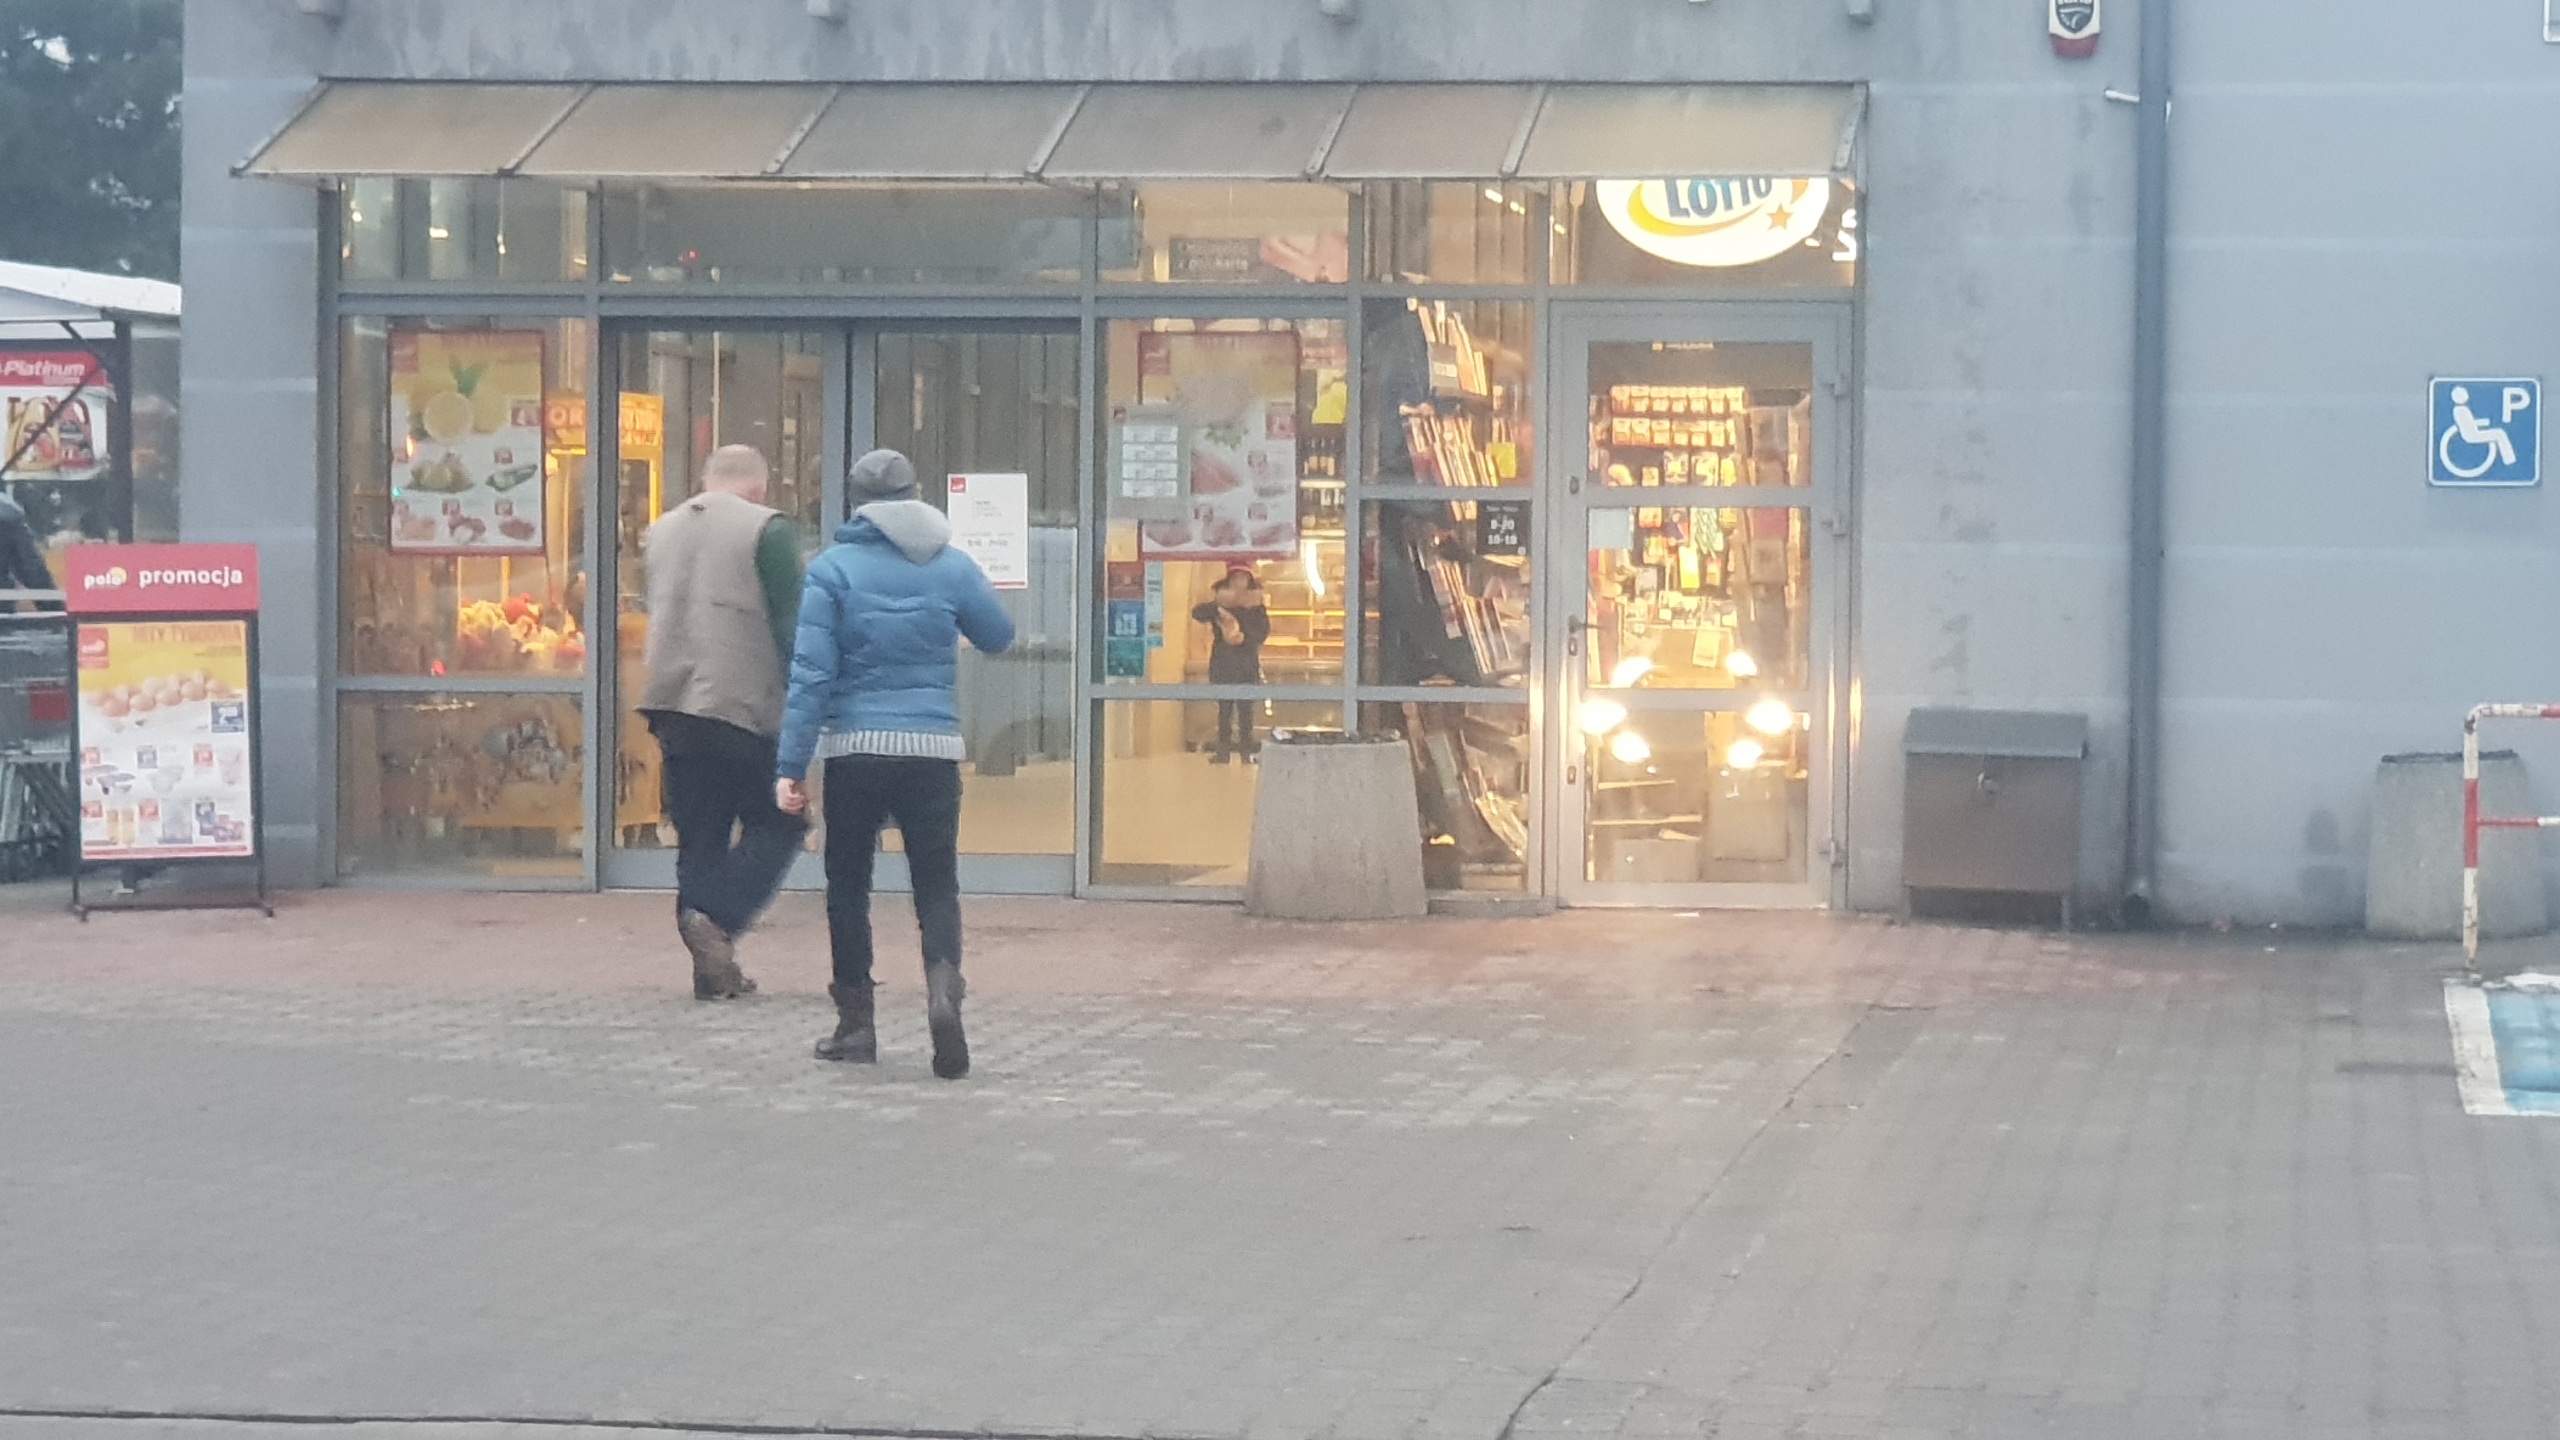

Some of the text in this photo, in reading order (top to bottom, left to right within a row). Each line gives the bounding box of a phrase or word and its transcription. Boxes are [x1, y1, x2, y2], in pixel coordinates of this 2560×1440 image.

[4, 360, 85, 377] Platinum
[2502, 386, 2531, 423] P
[139, 565, 243, 589] promocja
